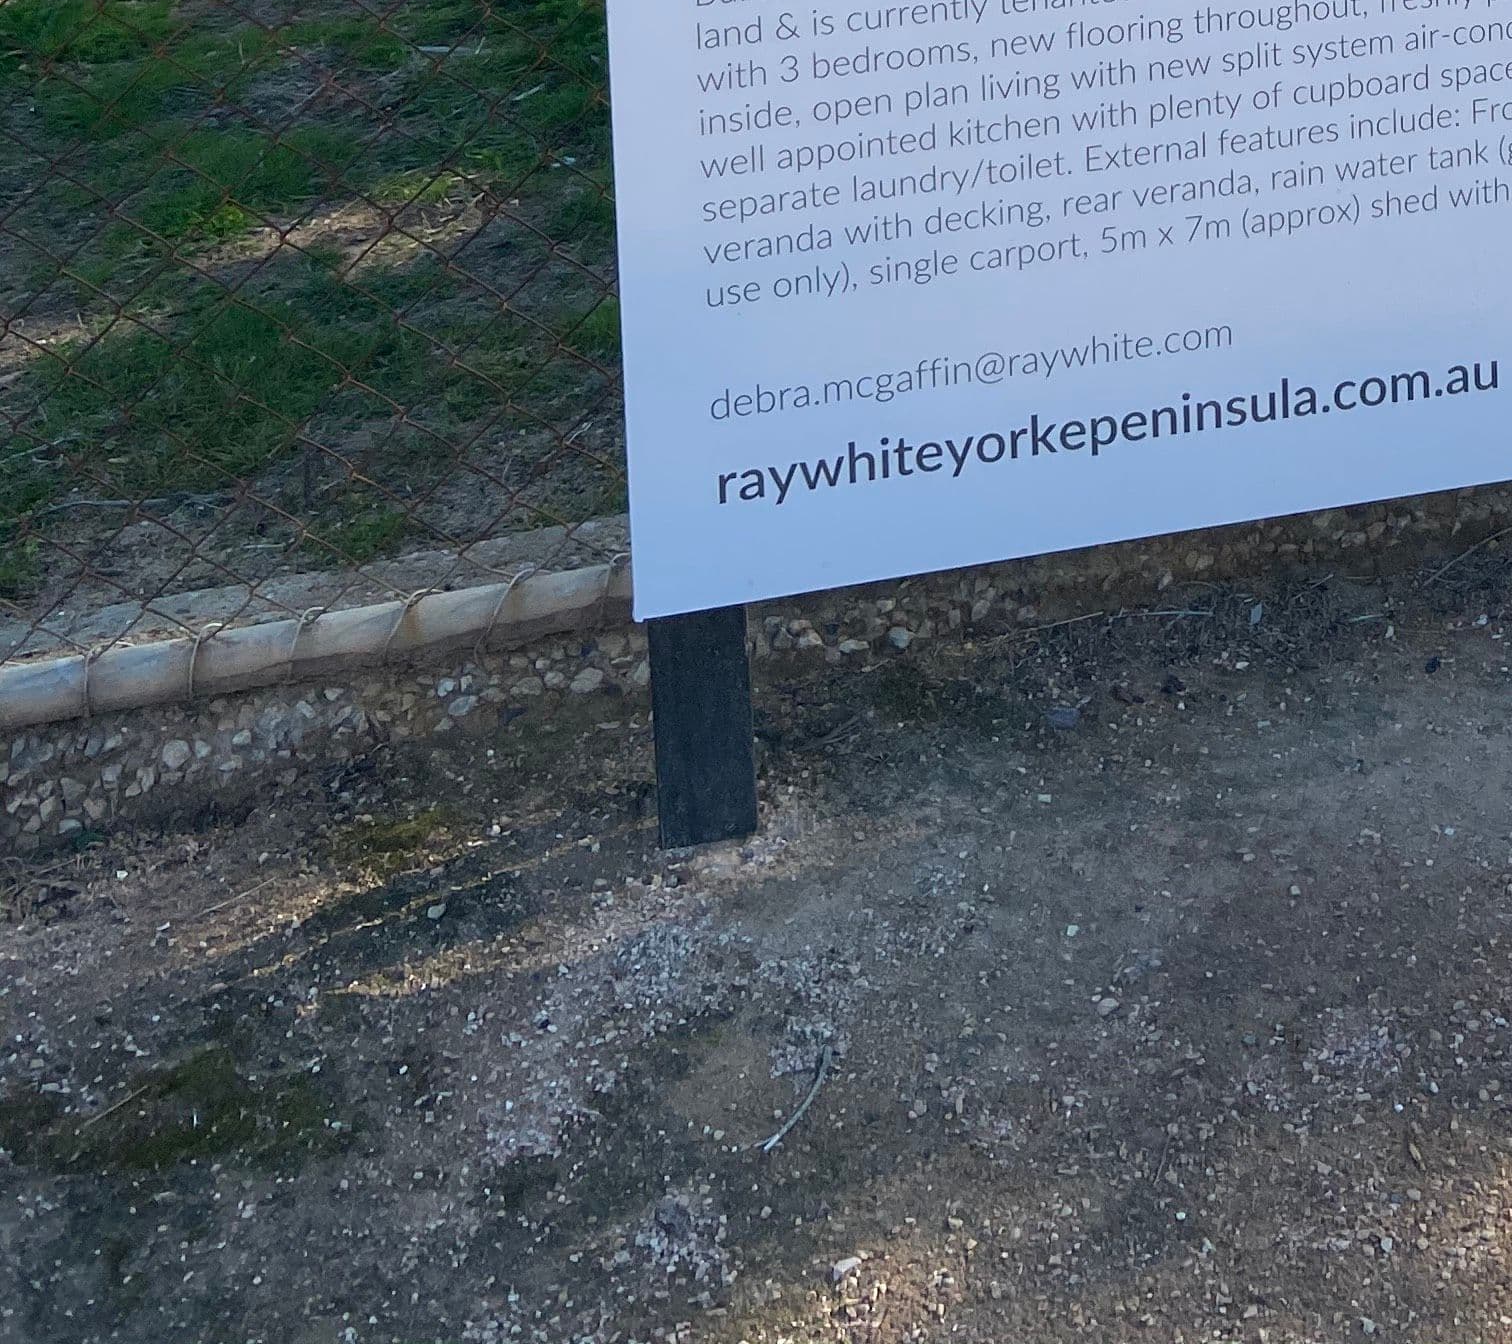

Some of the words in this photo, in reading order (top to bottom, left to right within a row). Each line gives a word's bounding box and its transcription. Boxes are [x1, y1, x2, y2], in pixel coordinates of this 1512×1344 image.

[697, 16, 762, 49] land
[776, 13, 800, 40] &
[813, 10, 834, 36] is
[697, 60, 766, 92] with
[780, 55, 799, 82] 3
[813, 42, 977, 79] bedrooms,
[992, 32, 1055, 57] new
[1066, 15, 1183, 49] flooring
[700, 100, 800, 136] inside,
[813, 94, 891, 125] open
[906, 81, 968, 117] plan
[982, 71, 1060, 101] living
[1071, 58, 1135, 90] with
[1149, 56, 1211, 81] new
[1223, 42, 1282, 77] split
[1293, 35, 1393, 68] system
[700, 144, 763, 178] well
[778, 123, 935, 173] appointed
[950, 114, 1059, 147] kitchen
[1072, 100, 1136, 132] with
[1150, 90, 1242, 128] plenty
[1253, 81, 1282, 110] of
[1294, 64, 1428, 107] cupboard
[703, 182, 840, 223] separate
[854, 152, 1072, 202] laundry/toilet.
[1086, 131, 1205, 172] External
[1218, 123, 1338, 155] features
[1350, 104, 1459, 139] include:
[704, 224, 832, 264] veranda
[844, 212, 911, 245] with
[925, 199, 1050, 234] decking,
[1064, 191, 1122, 217] rear
[1133, 168, 1259, 207] veranda,
[1272, 161, 1323, 190] rain
[1335, 153, 1418, 182] water
[1429, 139, 1488, 170] tank
[707, 282, 760, 307] use
[774, 261, 857, 297] only),
[870, 250, 958, 284] single
[970, 233, 1087, 270] carport,
[1102, 227, 1146, 253] 5m
[1158, 226, 1173, 247] x
[1185, 215, 1230, 242] 7m
[1243, 194, 1359, 238] (approx)
[1372, 185, 1437, 218] shed
[1449, 177, 1509, 208] with
[710, 322, 1234, 423] debra.mcgaffin@raywhite.com
[716, 359, 1500, 506] raywhiteyorkepeninsula.com.au
